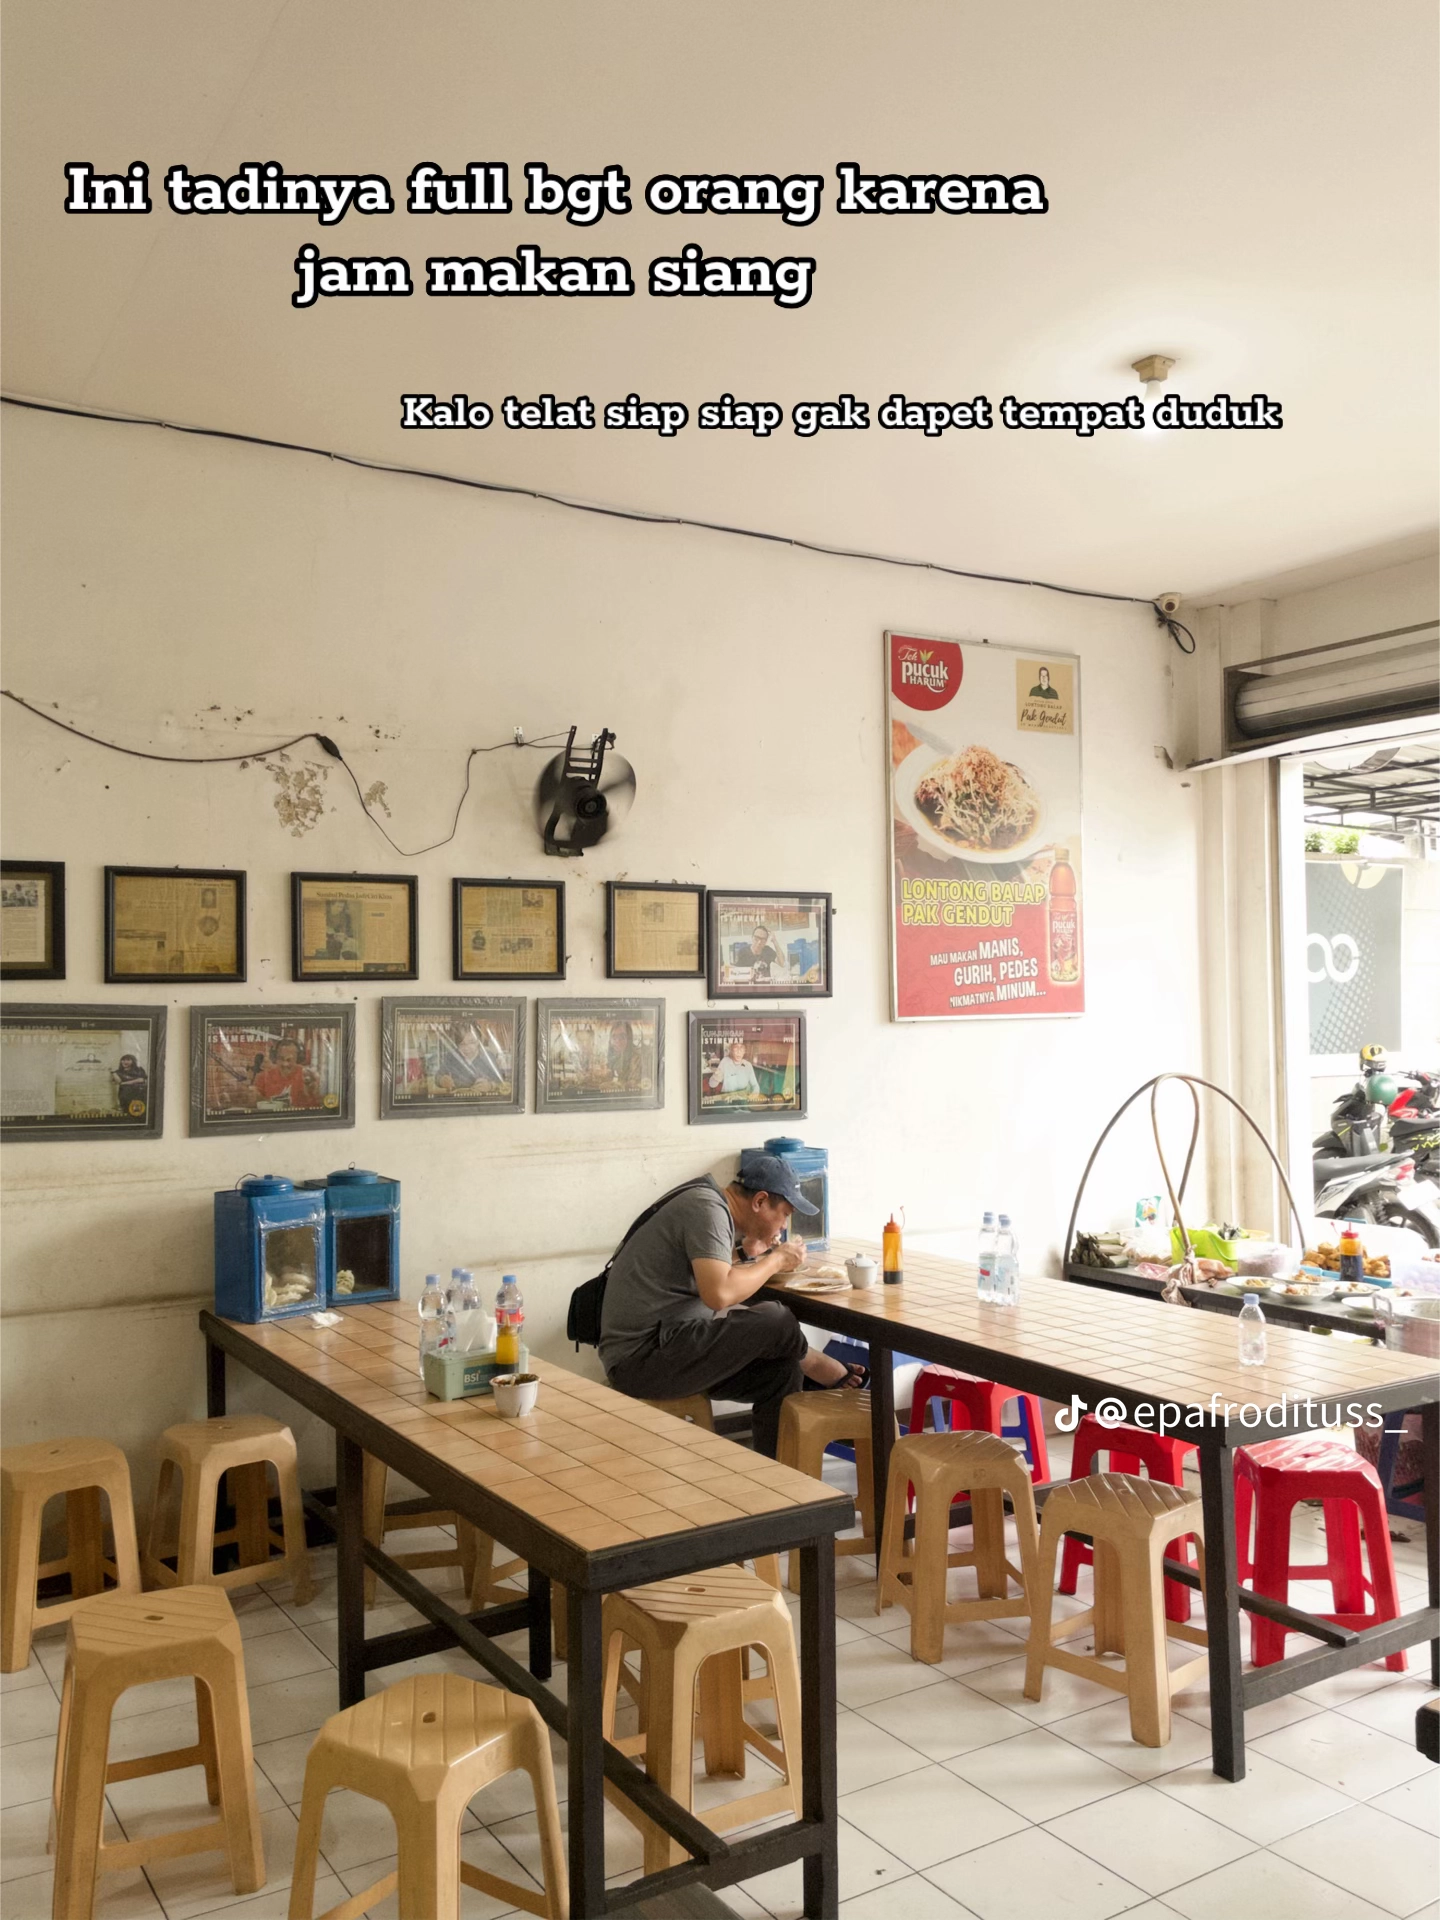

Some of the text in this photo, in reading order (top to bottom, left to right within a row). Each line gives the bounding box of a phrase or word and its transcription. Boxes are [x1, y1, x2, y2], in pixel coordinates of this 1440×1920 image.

[901, 660, 949, 684] pucuk
[909, 676, 946, 690] HARUM
[1020, 708, 1037, 722] Pak
[1039, 710, 1067, 727] Gendut
[902, 879, 1046, 903] LONTONG BALAP
[902, 903, 1014, 925] PAK GENDUT
[930, 937, 1024, 966] MAU MAKAN MANIS,
[954, 957, 1039, 987] GURIH, PEDES
[949, 981, 1047, 1009] NIKMATNYA MINUM...
[464, 1372, 480, 1383] BSI
